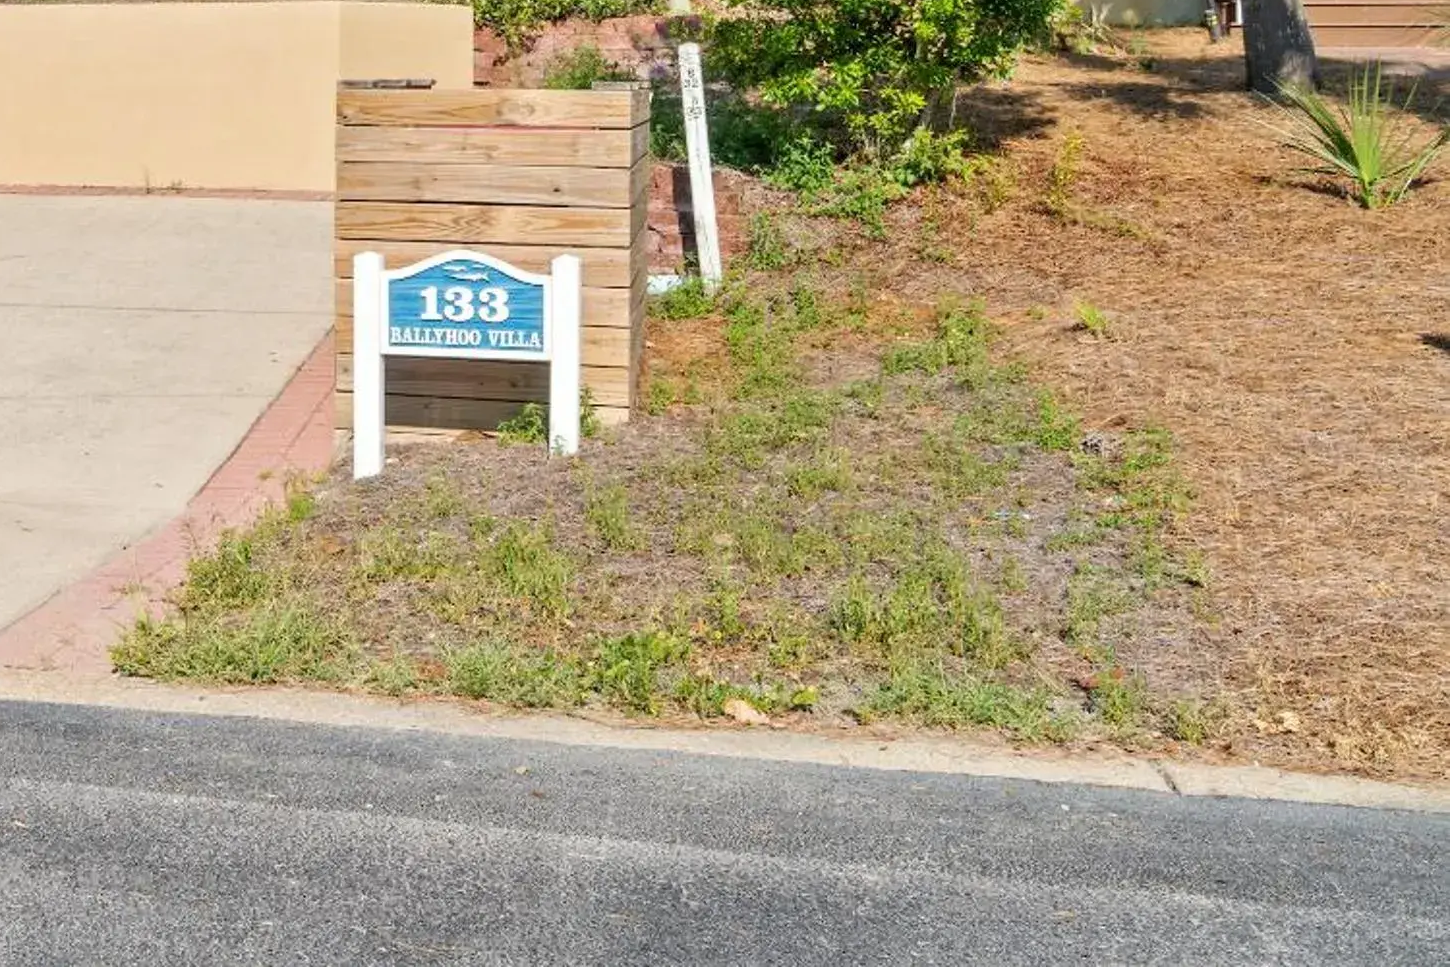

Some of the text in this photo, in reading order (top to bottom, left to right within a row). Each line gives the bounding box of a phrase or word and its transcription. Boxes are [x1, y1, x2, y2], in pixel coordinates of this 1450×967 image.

[419, 286, 510, 323] 133
[389, 327, 542, 348] BALLYHOO VILLA
